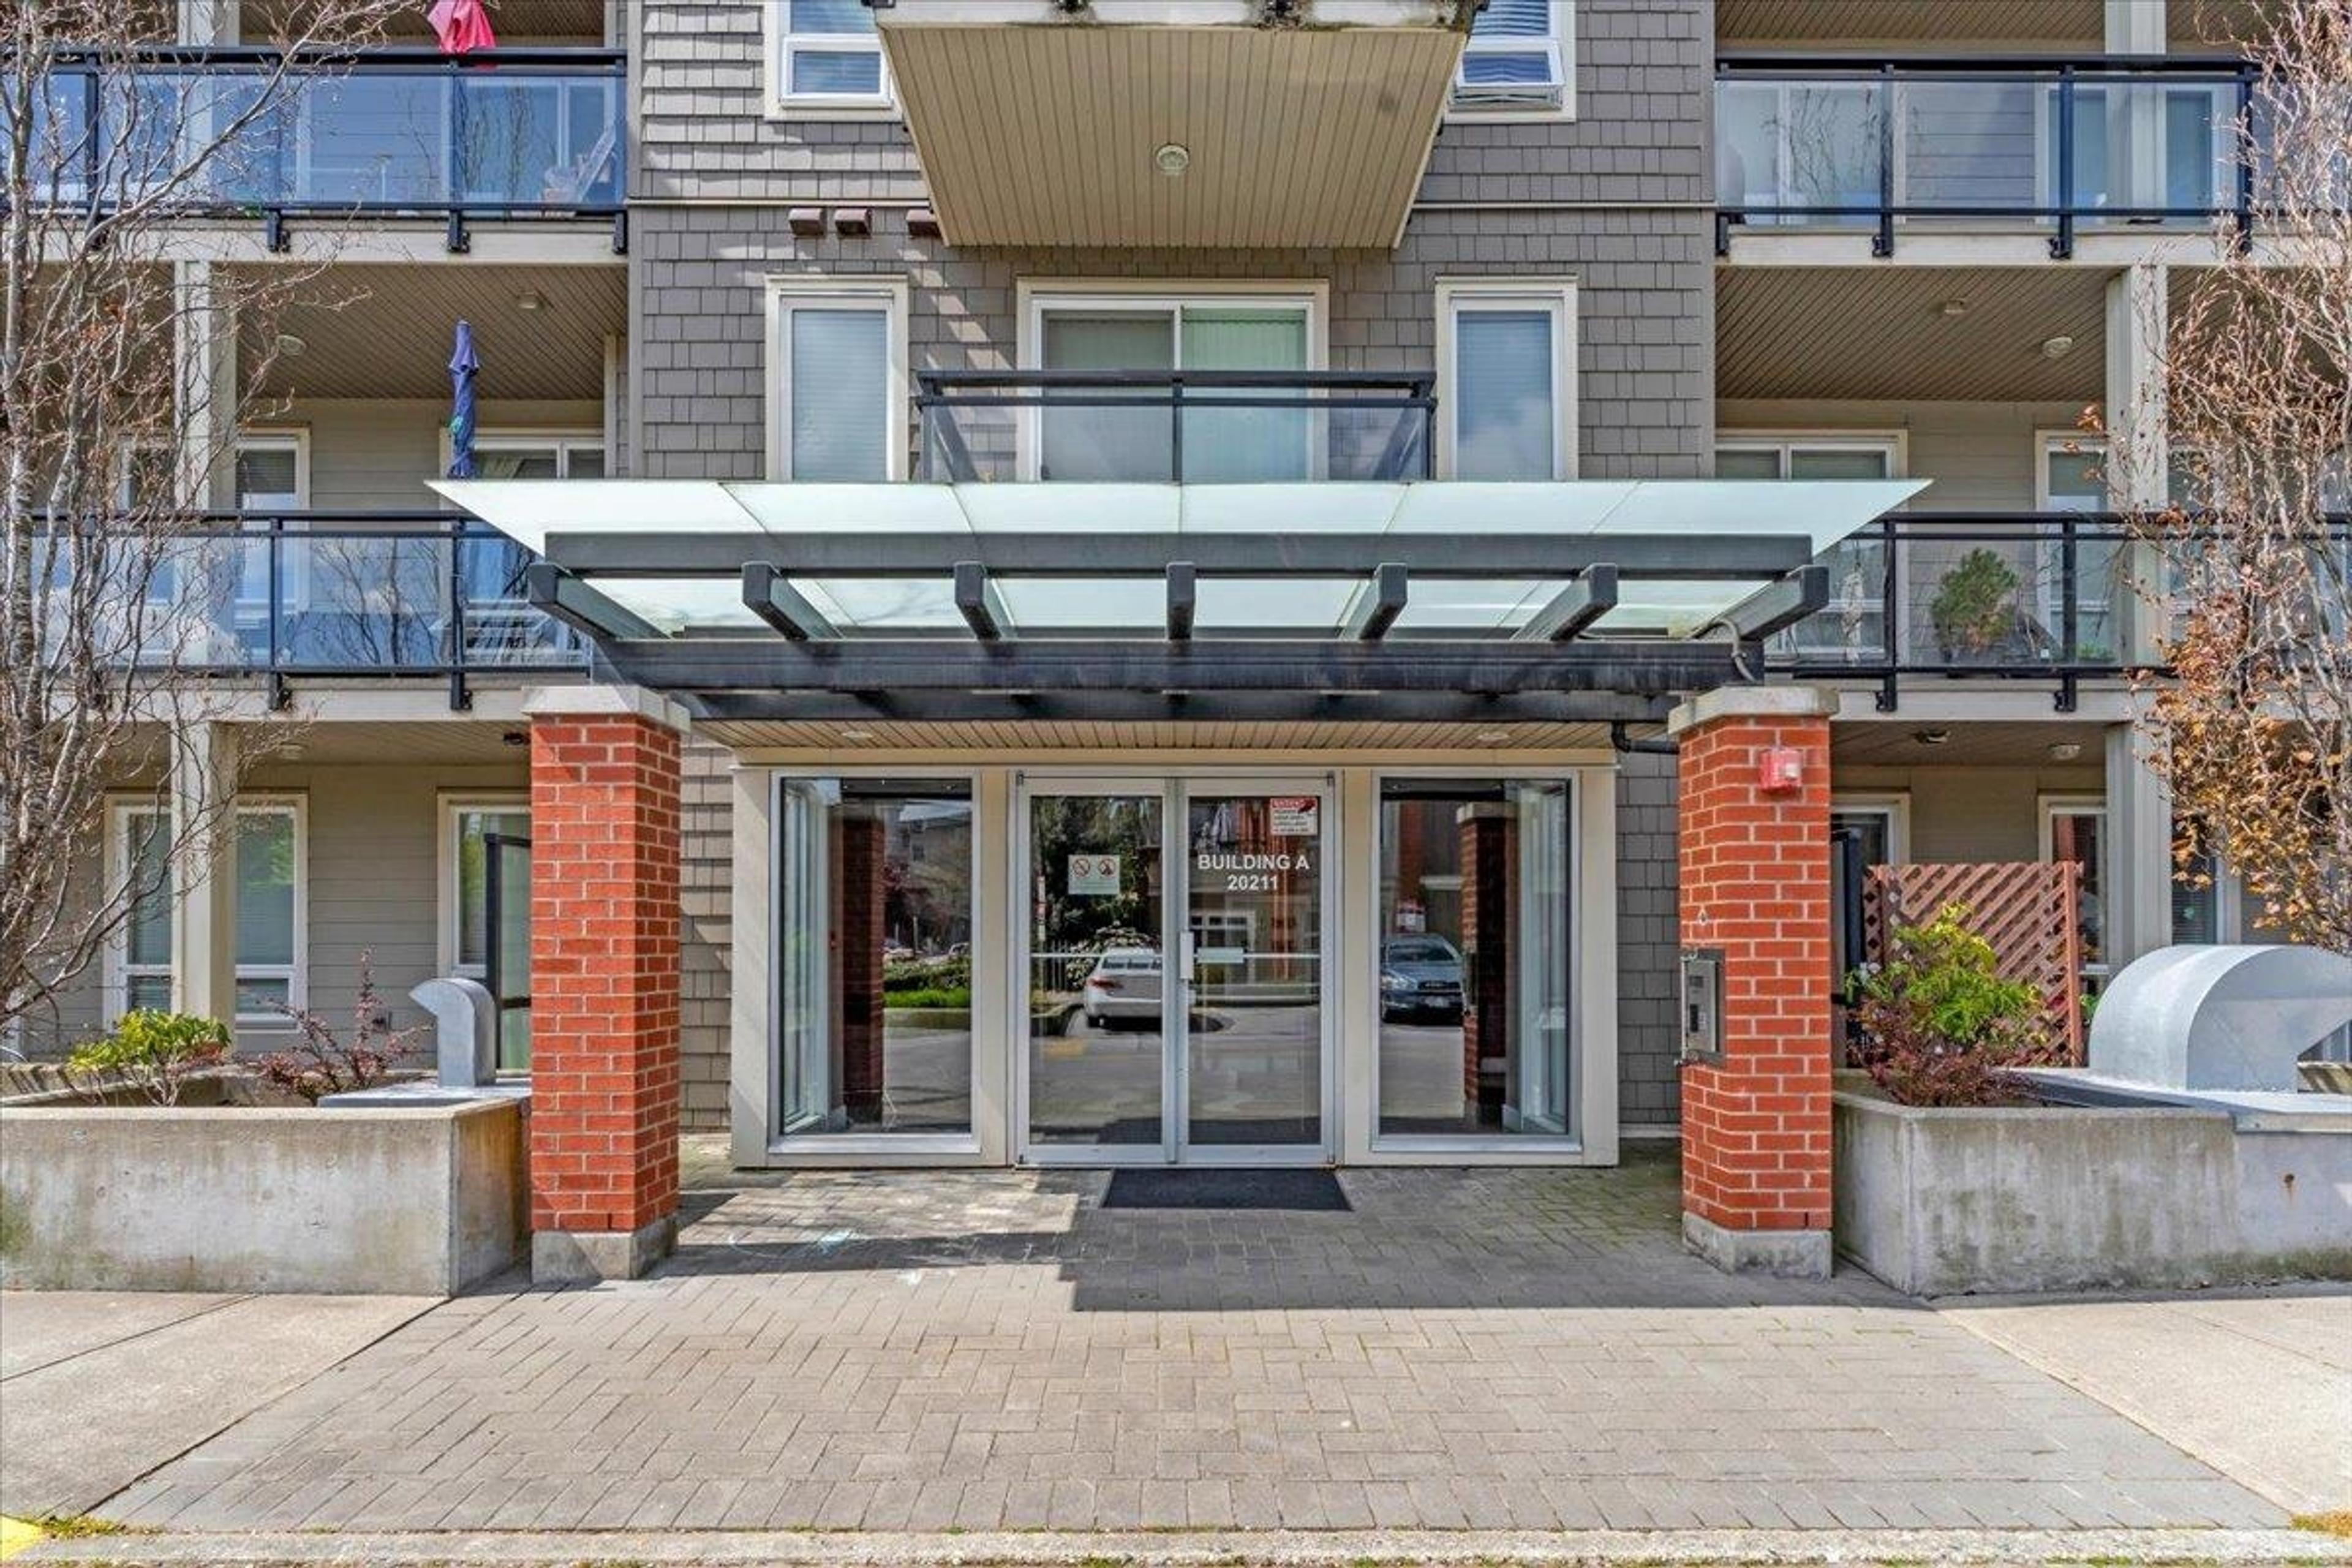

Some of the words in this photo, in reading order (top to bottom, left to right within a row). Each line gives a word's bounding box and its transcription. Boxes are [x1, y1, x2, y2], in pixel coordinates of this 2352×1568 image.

[1198, 854, 1291, 870] BUILDING
[1295, 854, 1310, 870] A
[1227, 874, 1278, 890] 20211
